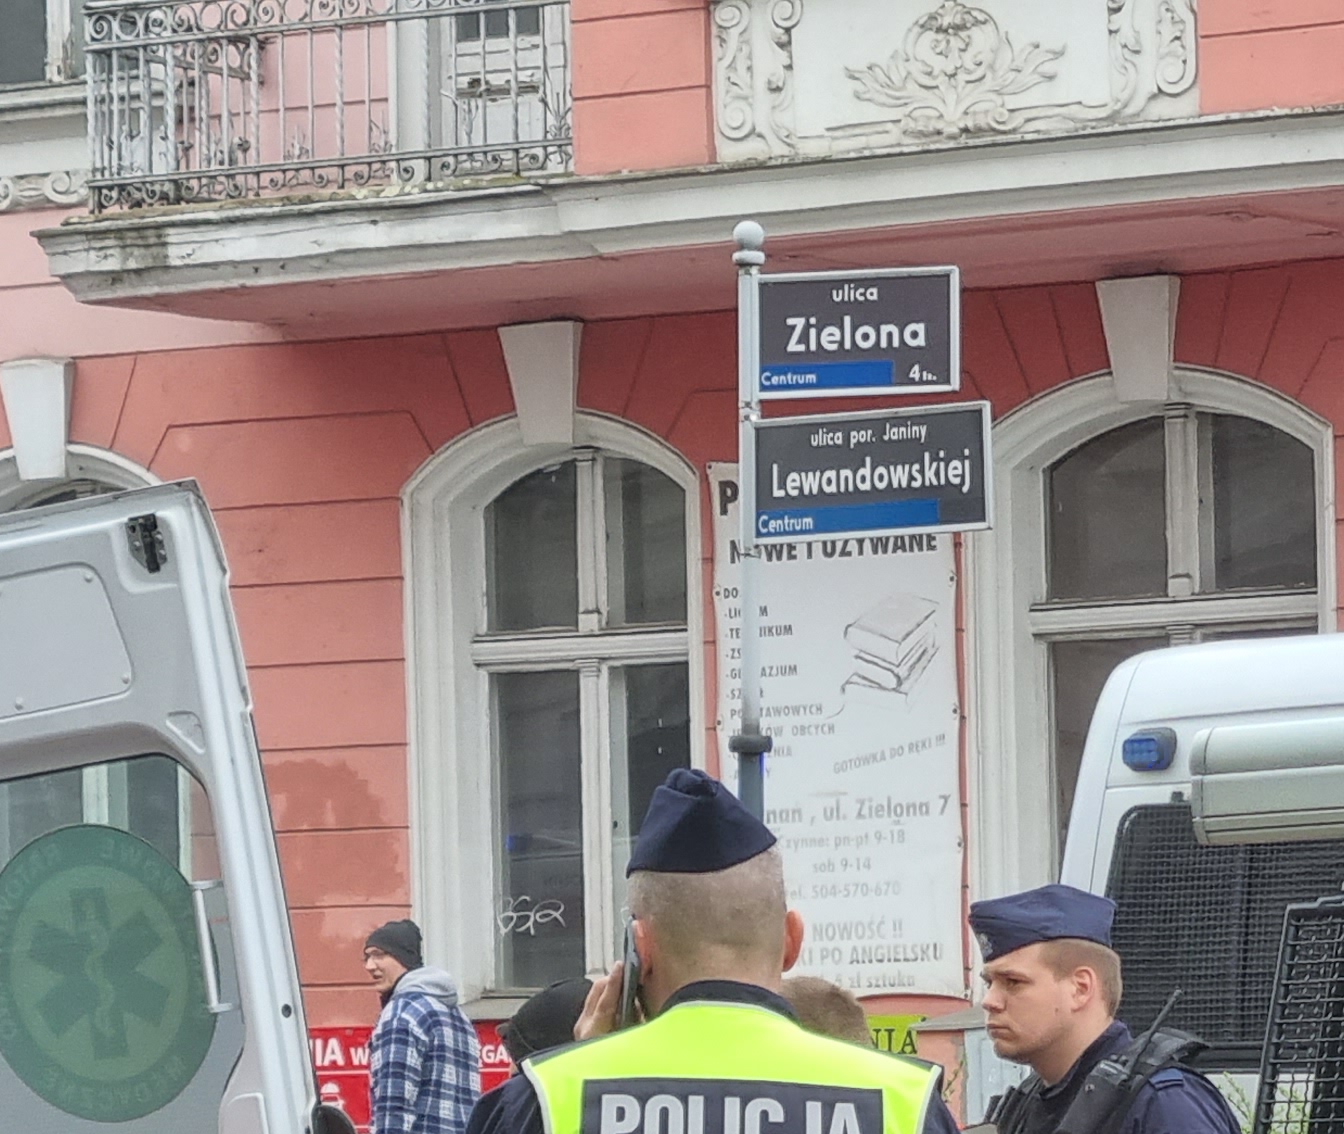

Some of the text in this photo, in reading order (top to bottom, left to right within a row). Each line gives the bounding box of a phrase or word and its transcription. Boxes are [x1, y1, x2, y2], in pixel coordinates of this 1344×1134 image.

[832, 284, 879, 303] ulica
[786, 315, 927, 353] Zielona
[761, 371, 817, 386] Centrum
[810, 421, 928, 449] ulica por. Janiny
[771, 448, 971, 498] Lewandowskiej
[758, 516, 814, 534] Centrum
[791, 723, 835, 738] OBCYCH
[889, 745, 905, 760] DO
[822, 798, 847, 822] ul.
[855, 796, 930, 821] Zielona
[939, 794, 951, 817] 7
[874, 829, 905, 845] 9-18
[813, 857, 872, 873] sob 9-14
[812, 915, 887, 942] NOWOŚĆ
[819, 947, 843, 966] PO
[849, 942, 944, 965] ANGIELSKU
